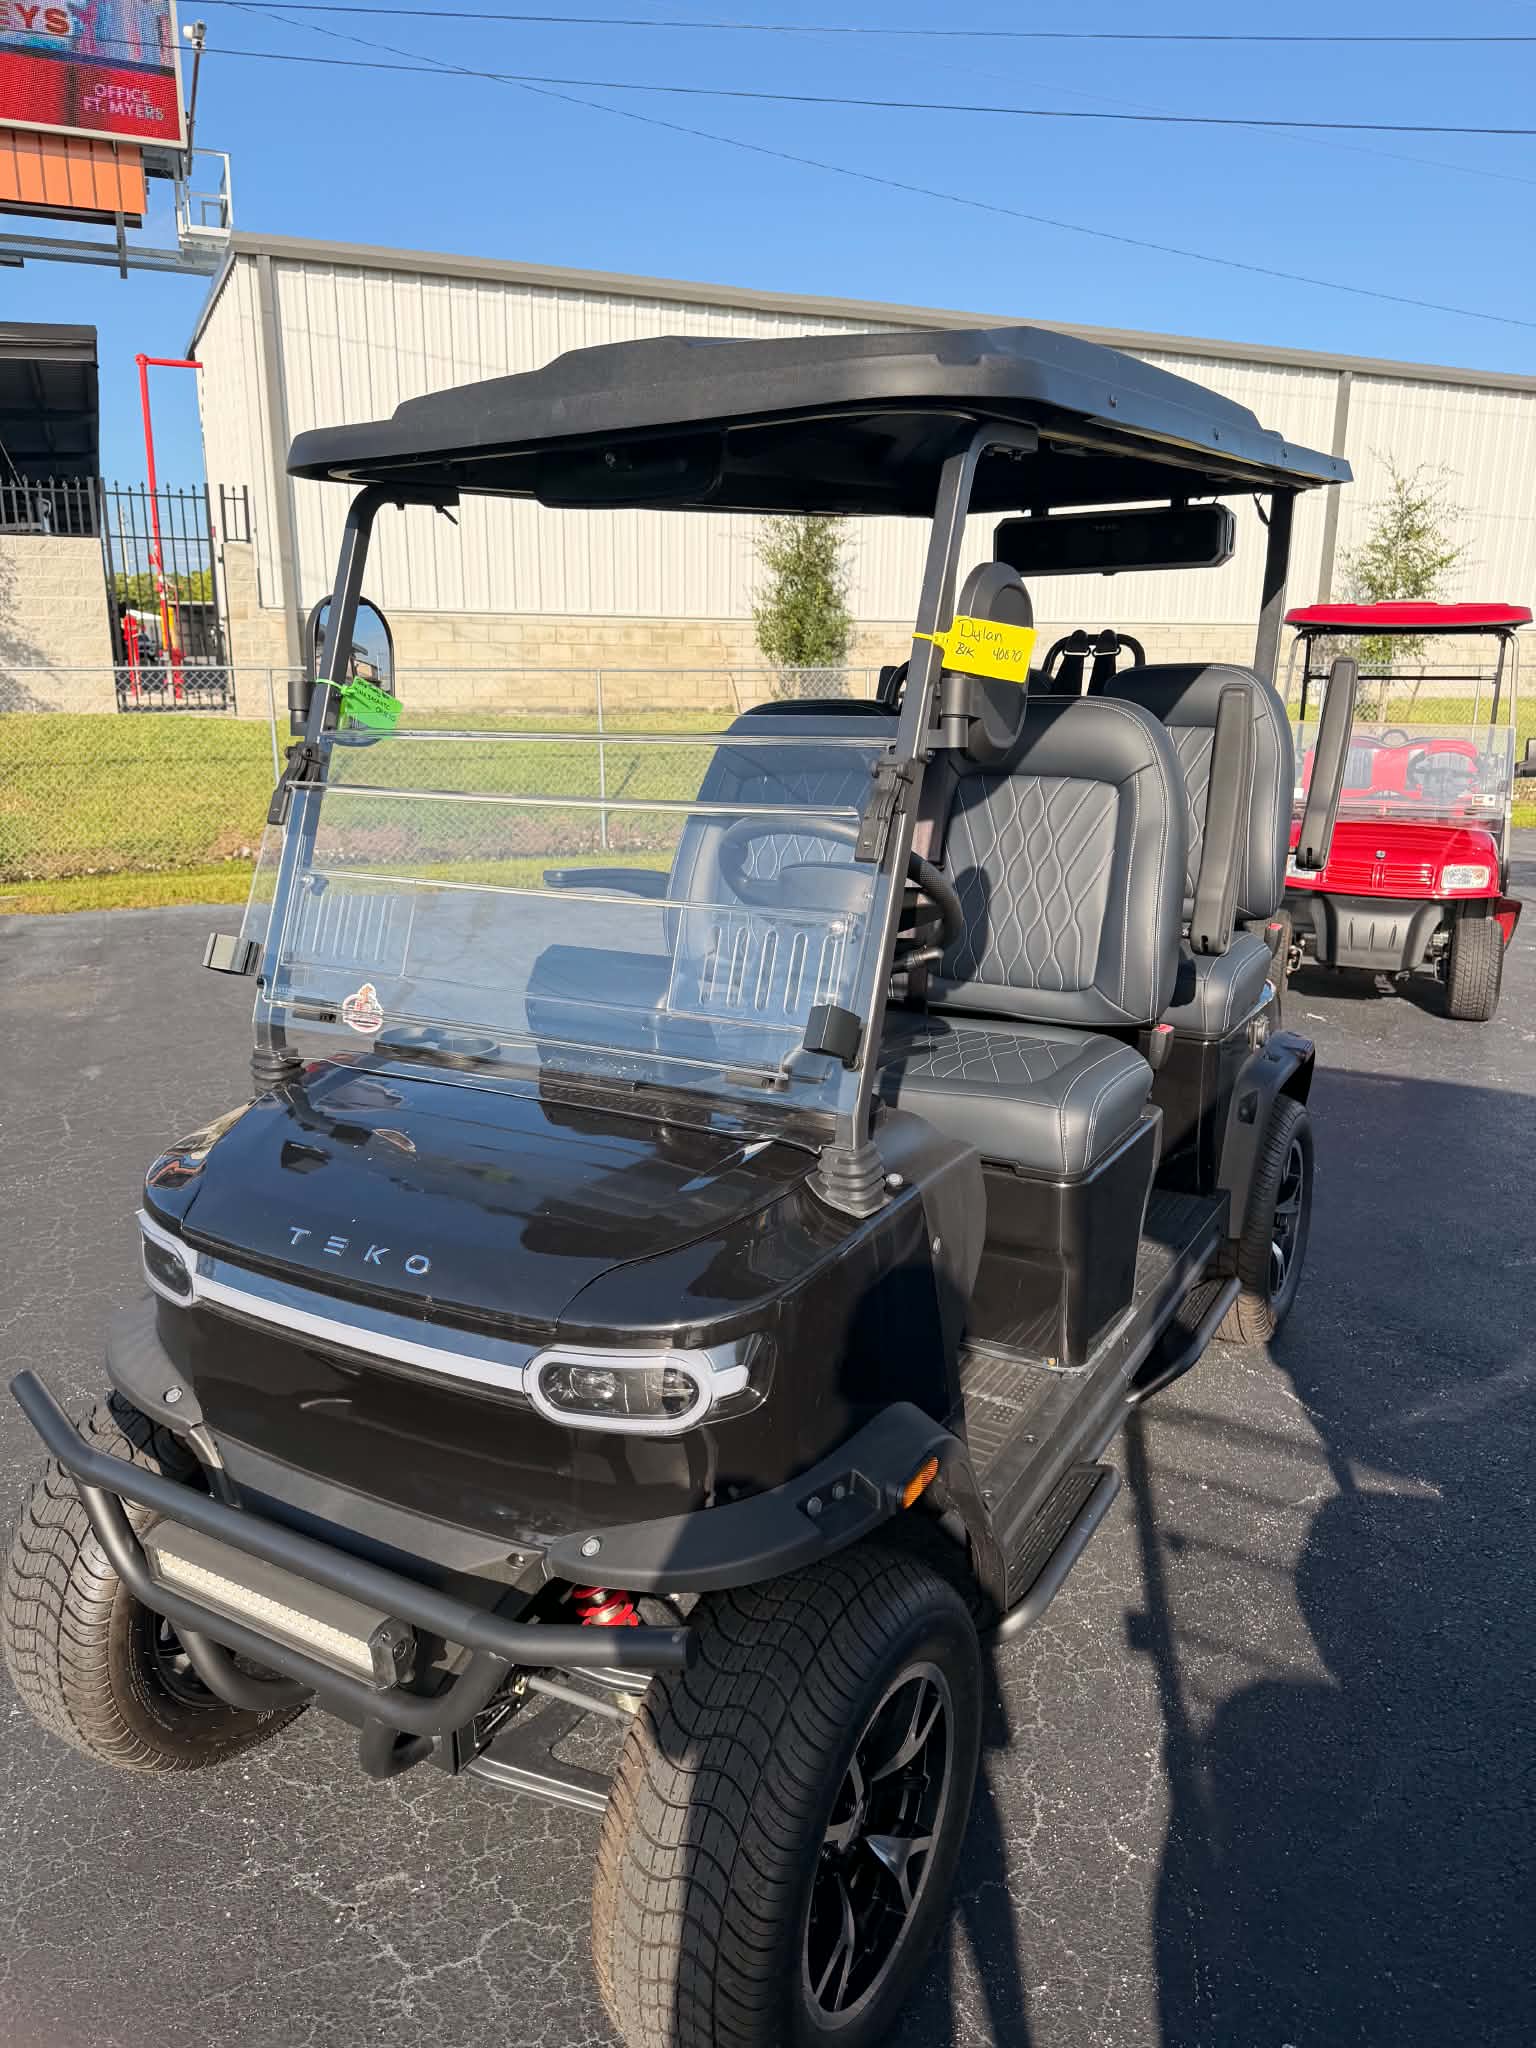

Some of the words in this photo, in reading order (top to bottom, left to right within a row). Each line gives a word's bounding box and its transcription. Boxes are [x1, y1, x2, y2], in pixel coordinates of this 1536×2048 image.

[95, 83, 151, 103] OFFICE
[109, 102, 164, 121] MYERS
[958, 619, 1003, 642] Dylan
[289, 1226, 430, 1275] TEKO
